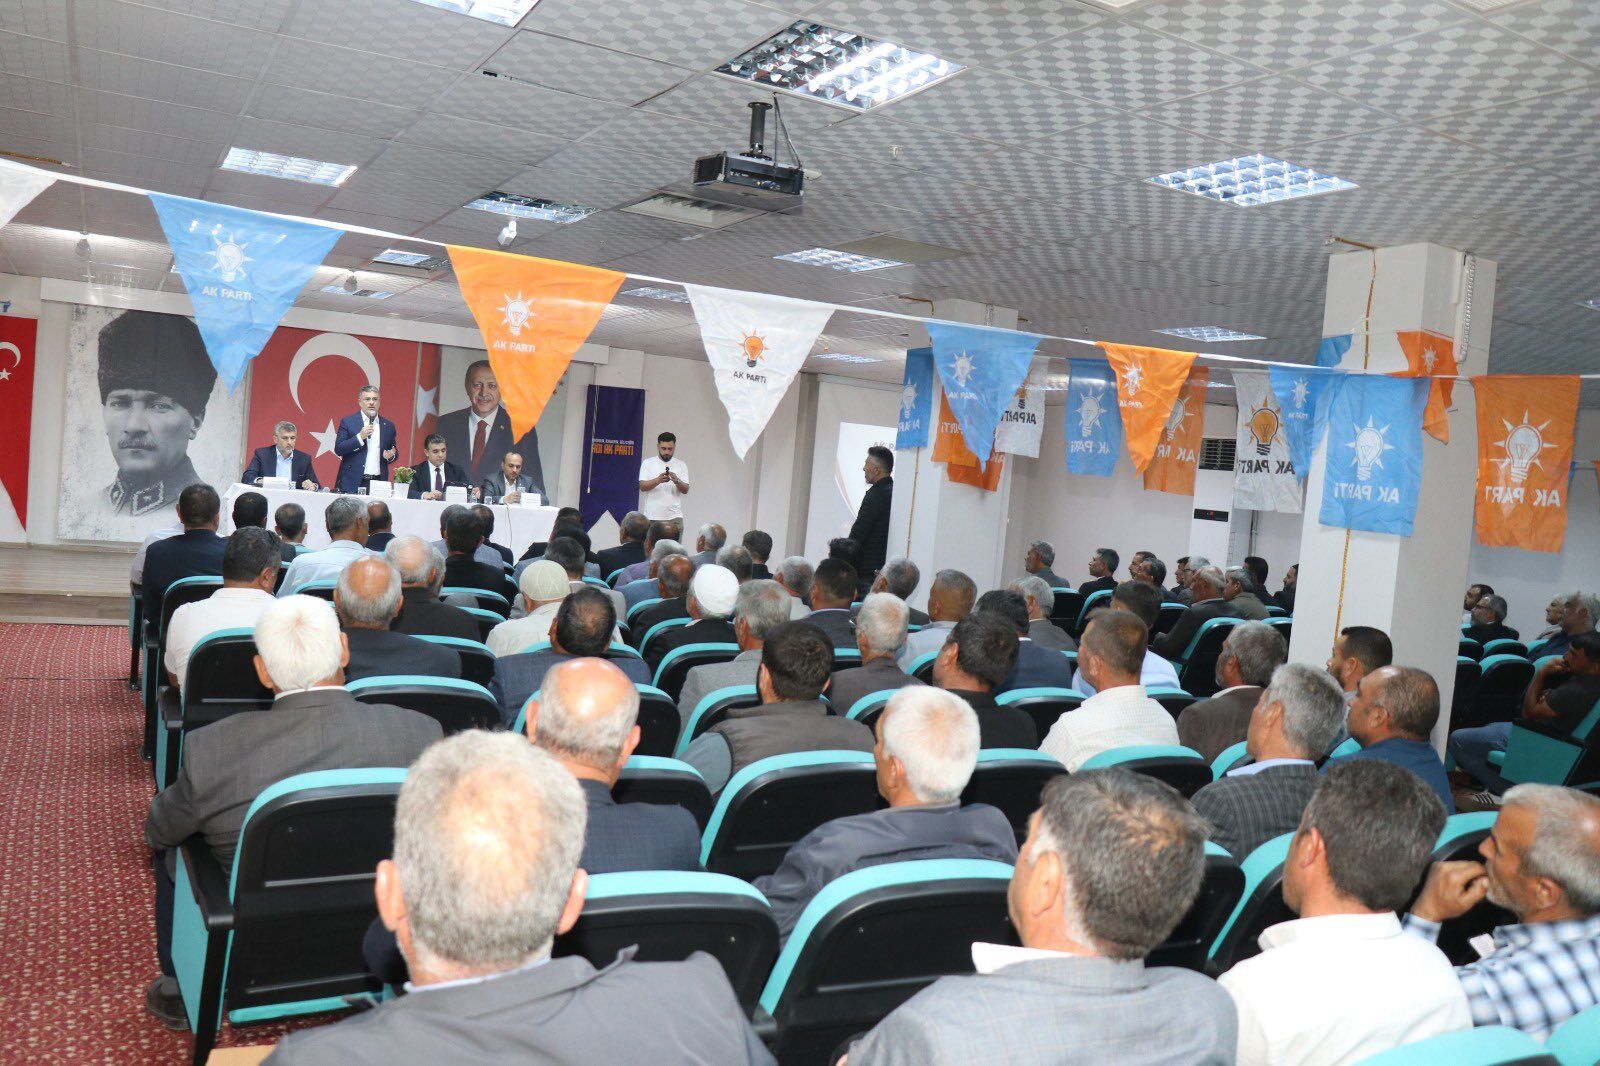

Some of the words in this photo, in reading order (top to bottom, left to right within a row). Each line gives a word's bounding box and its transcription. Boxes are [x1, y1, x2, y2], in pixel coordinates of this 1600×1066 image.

[201, 286, 218, 297] AK
[493, 339, 507, 350] AK
[733, 371, 744, 379] AK
